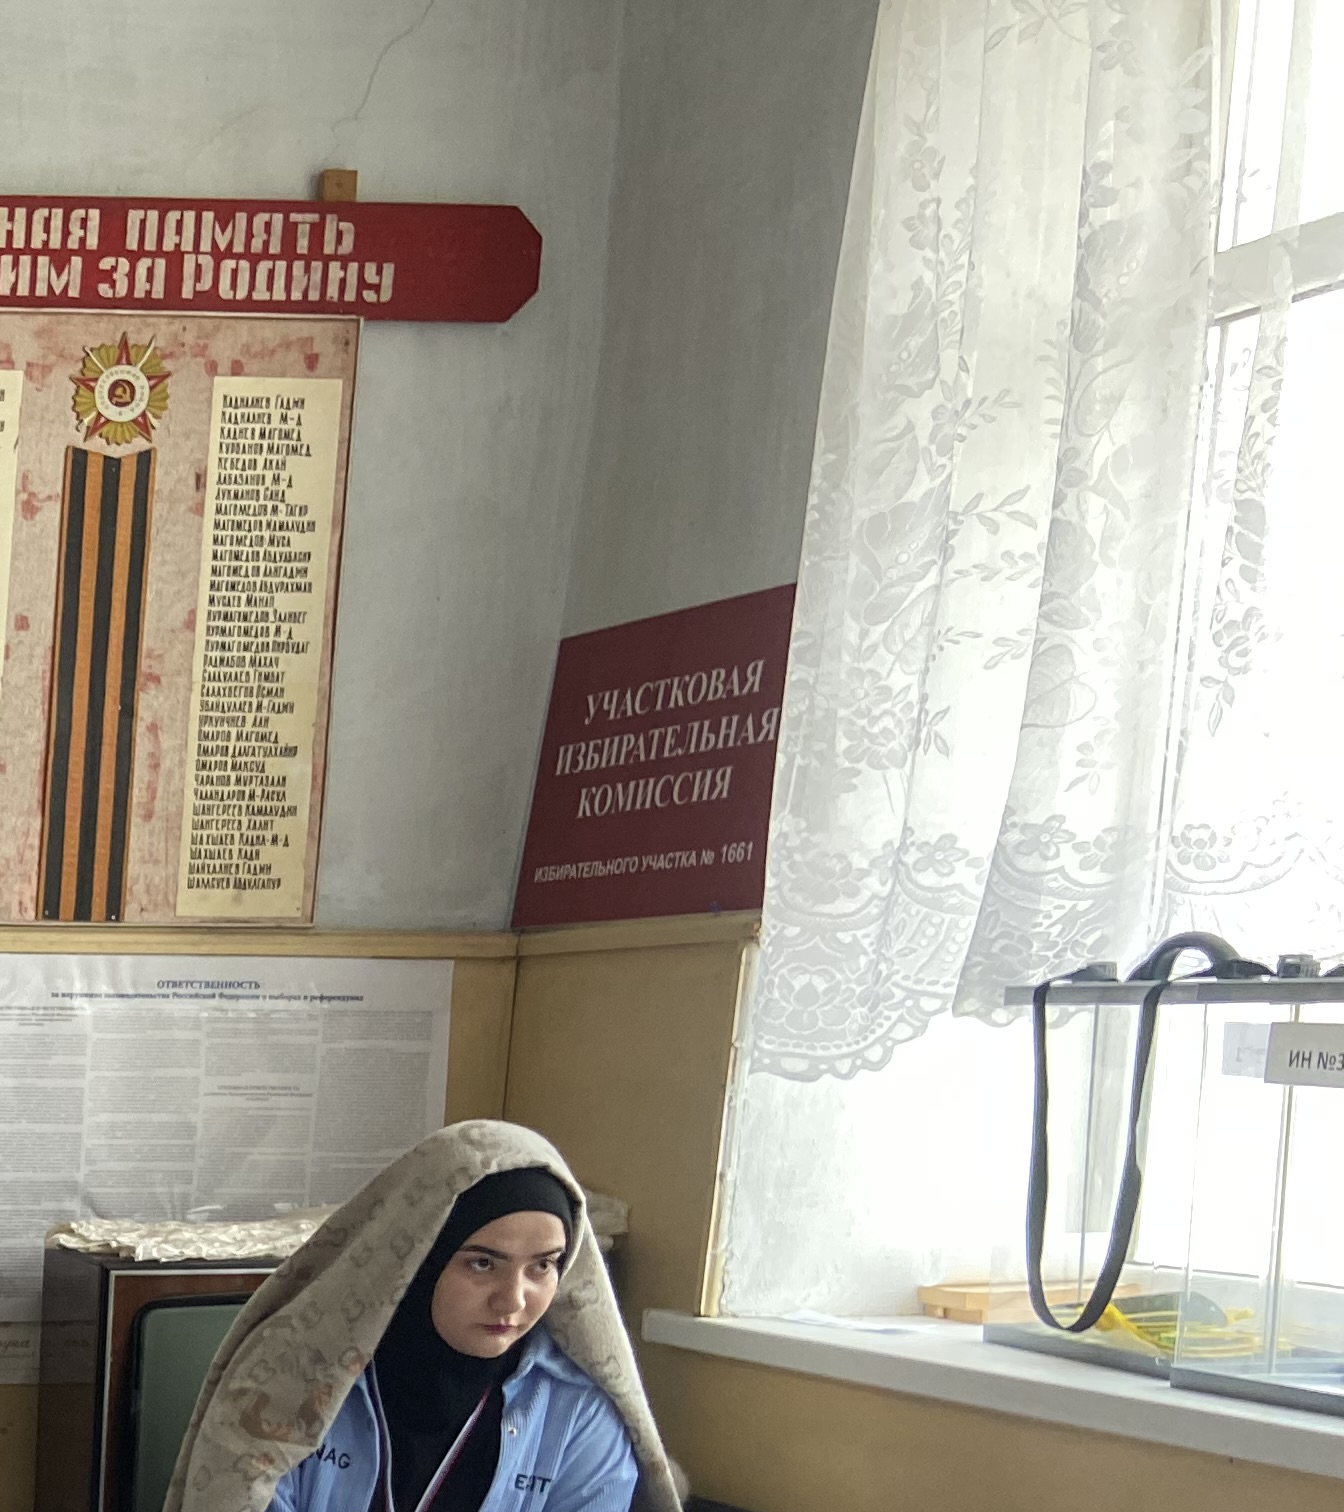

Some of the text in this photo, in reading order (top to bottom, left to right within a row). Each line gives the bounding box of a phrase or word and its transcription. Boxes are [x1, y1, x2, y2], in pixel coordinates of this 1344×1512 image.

[126, 208, 354, 255] ПАМЯТЬ
[97, 256, 166, 299] ЗА
[266, 442, 312, 457] МАГОМЕД
[584, 659, 765, 725] УЧАСТКОВАЯ
[235, 729, 278, 744] МАГОМЕД
[555, 706, 782, 776] ИЗБИРАТЕЛЬНАЯ
[576, 766, 733, 819] КОМИССИЯ
[534, 855, 638, 883] ИЗБИРАТЕЛЬНОГО
[641, 849, 697, 872] УЧАСТКА
[721, 841, 754, 864] 1661
[156, 980, 260, 990] ОТВЕТСТВЕННОСТЬ
[1289, 1050, 1312, 1069] ИН
